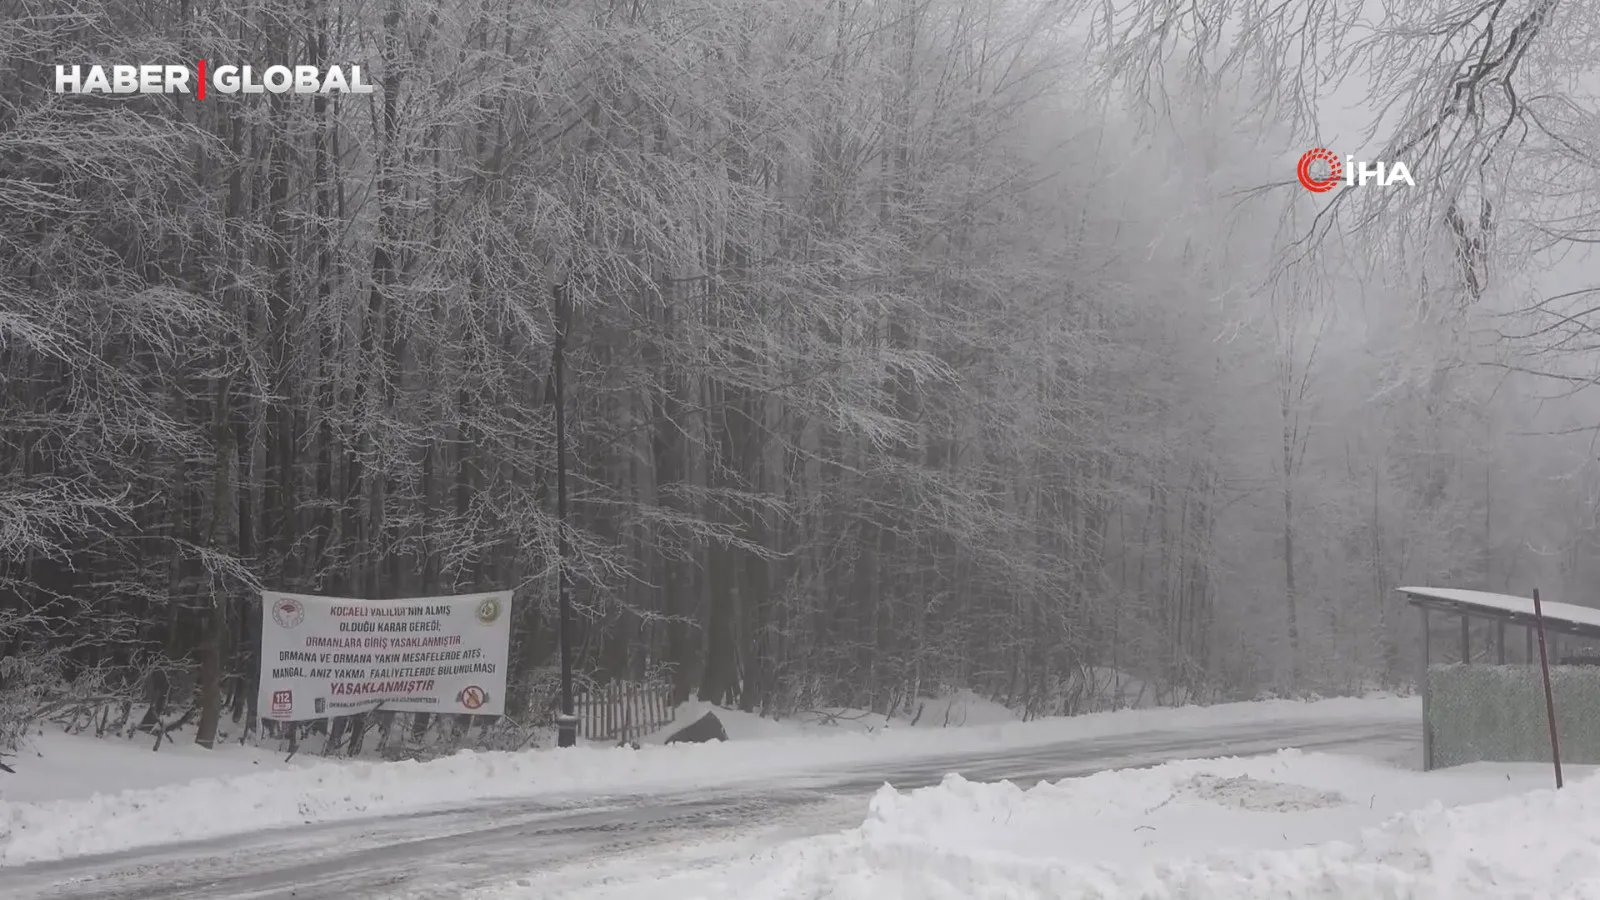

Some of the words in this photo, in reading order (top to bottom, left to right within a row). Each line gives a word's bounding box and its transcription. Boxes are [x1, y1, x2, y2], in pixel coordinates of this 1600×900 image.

[425, 604, 451, 616] ALMIŞ
[339, 621, 375, 633] OLDUĞU
[377, 622, 408, 633] KARAR
[306, 637, 362, 649] ORMANLARA
[364, 636, 388, 649] GİRİŞ
[279, 650, 317, 663] ORMANA
[319, 652, 331, 663] VE
[333, 652, 373, 664] ORMANA
[375, 651, 400, 663] YAKIN
[402, 649, 461, 663] MESAFELERDE
[310, 668, 332, 679] ANIZ
[334, 668, 365, 679] YAKMA
[437, 663, 496, 676] BULUNULMASI
[330, 679, 435, 696] YASAKLANMIŞTIR
[276, 692, 290, 703] 112
